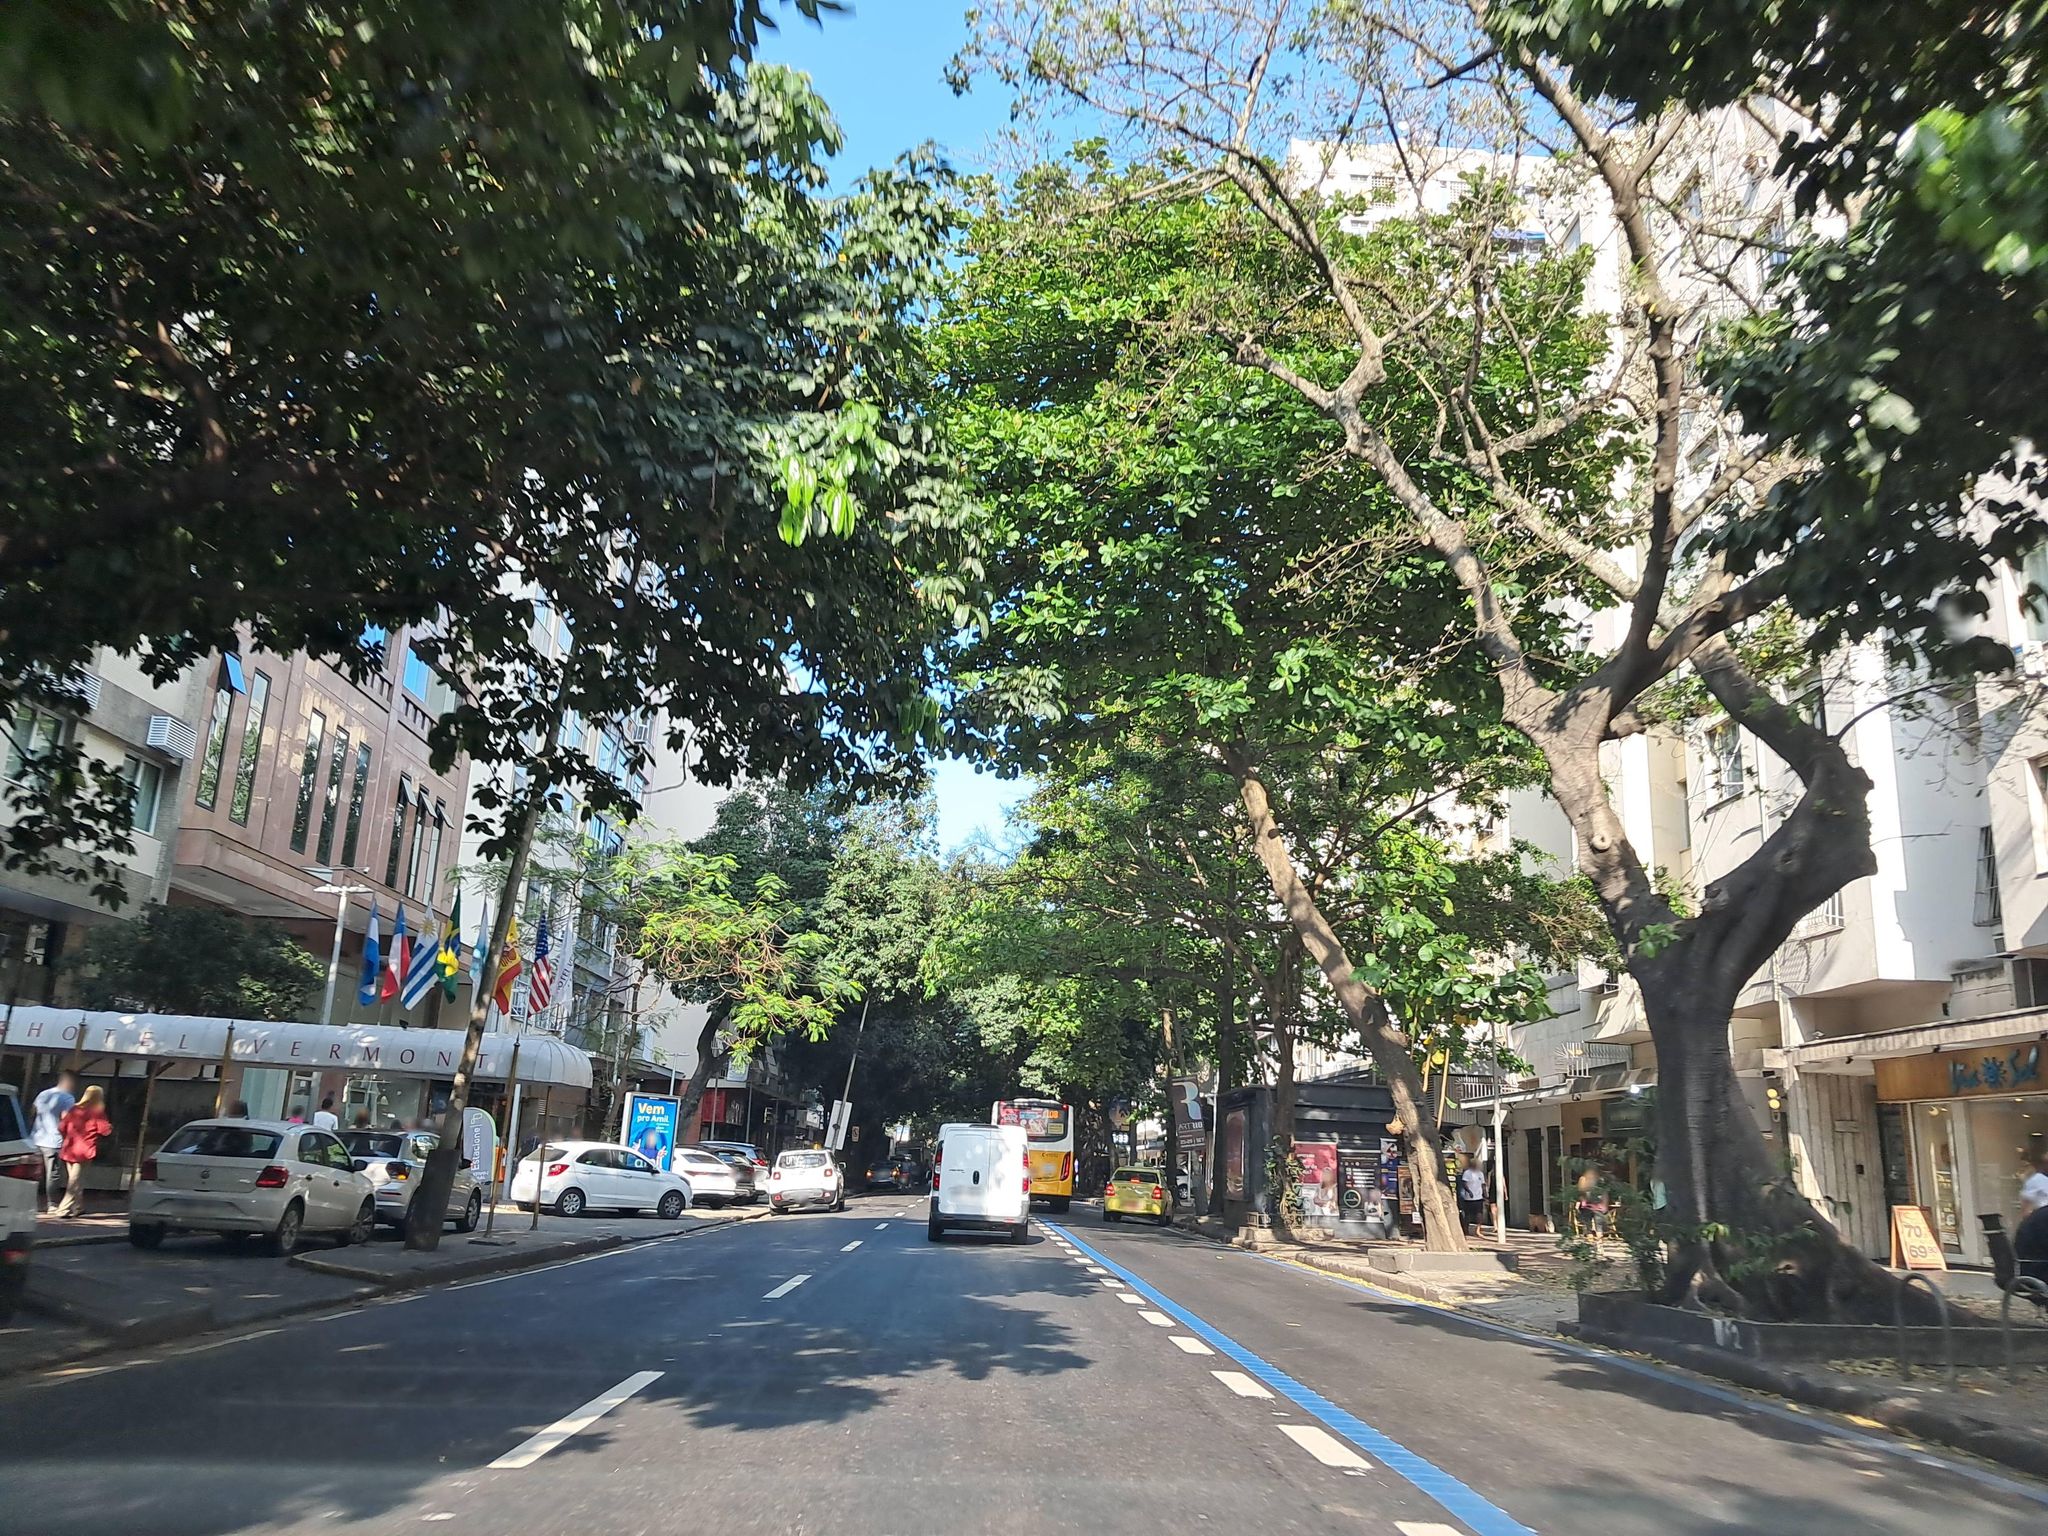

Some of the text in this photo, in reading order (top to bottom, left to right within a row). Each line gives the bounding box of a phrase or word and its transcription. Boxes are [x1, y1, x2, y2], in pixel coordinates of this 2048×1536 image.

[28, 1022, 489, 1069] HOTEL VERMONT
[637, 1115, 650, 1123] pro
[638, 1103, 665, 1115] Vem
[471, 1127, 481, 1171] Estacione
